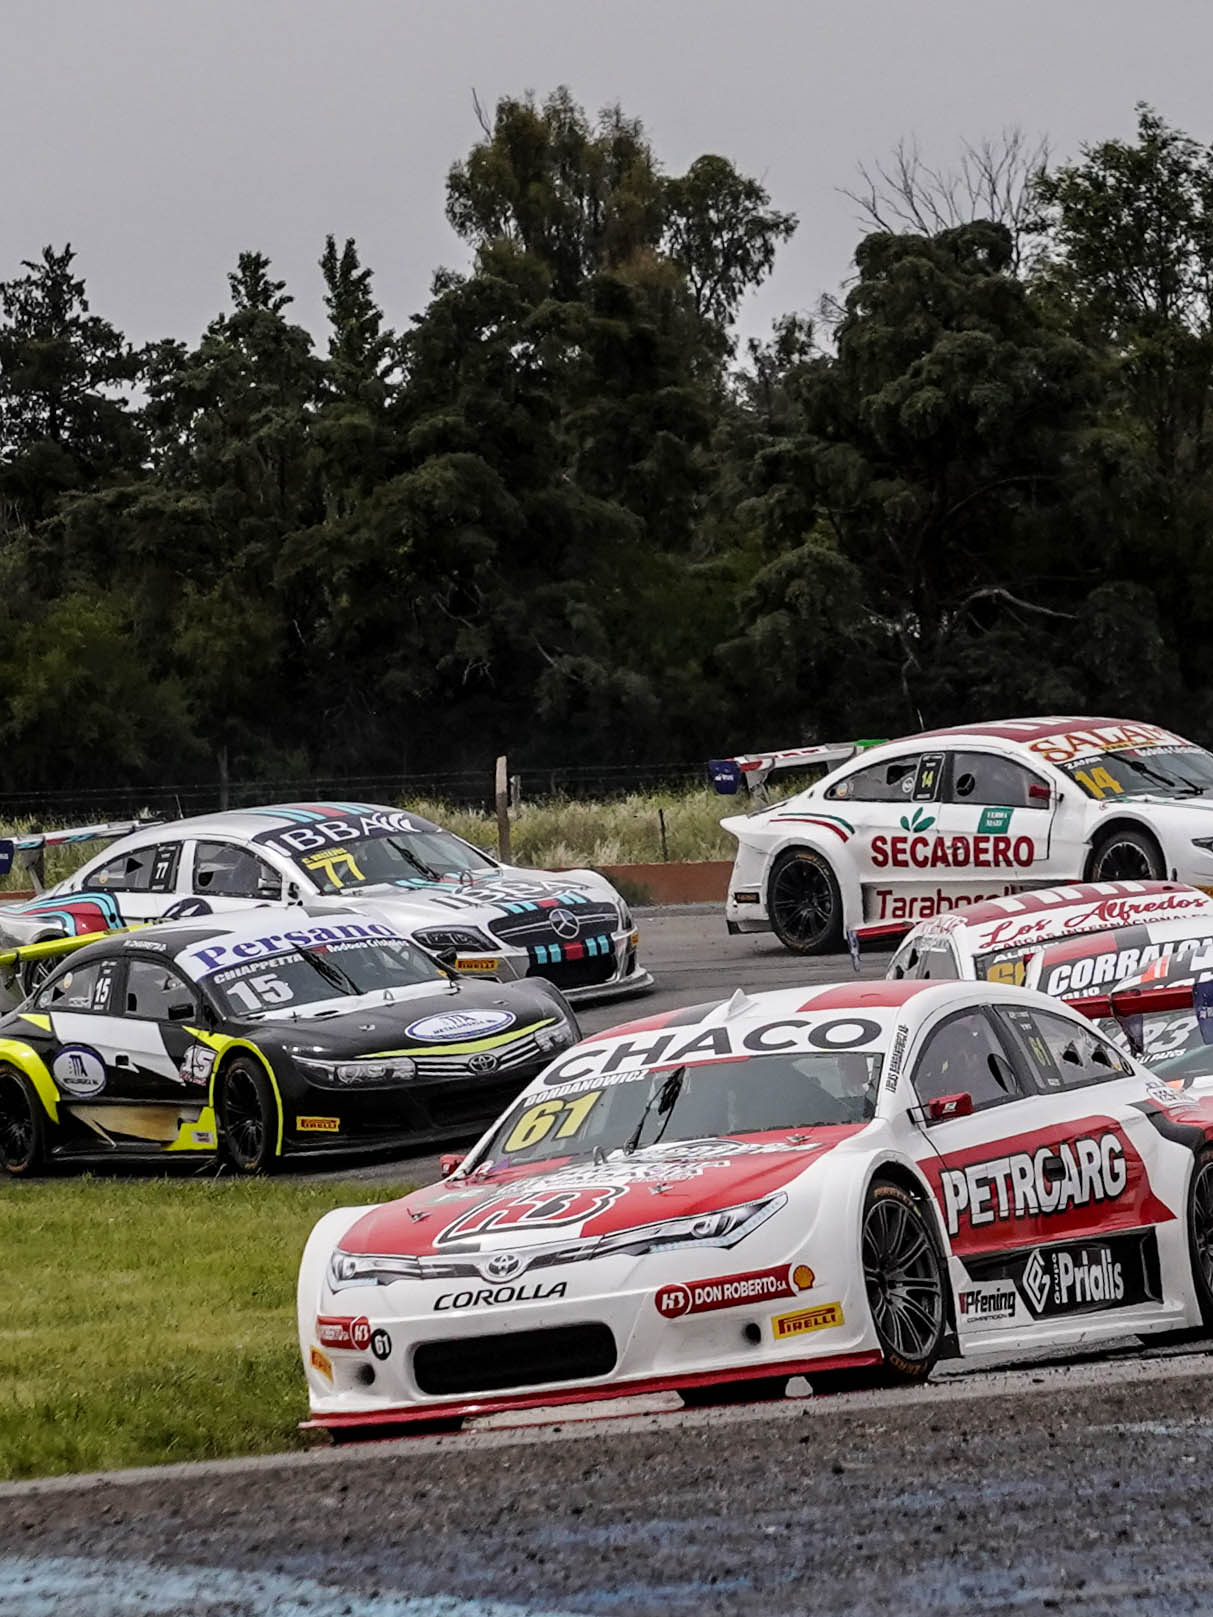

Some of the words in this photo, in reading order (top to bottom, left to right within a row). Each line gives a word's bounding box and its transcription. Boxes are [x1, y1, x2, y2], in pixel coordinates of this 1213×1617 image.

[1075, 767, 1124, 799] 14
[871, 835, 1035, 868] SECADERO
[306, 853, 366, 888] 77
[979, 917, 1052, 949] Los
[1065, 895, 1208, 927] Alfredos
[192, 924, 396, 971] Persano
[95, 978, 111, 1003] 15
[226, 974, 294, 1010] 15
[543, 1018, 882, 1086] CHACO
[523, 1069, 648, 1108] BOHDANOWICZ
[505, 1091, 602, 1153] 61
[695, 1287, 722, 1304] DON
[724, 1276, 776, 1299] ROBERTO
[1058, 1249, 1124, 1304] Prialis
[434, 1281, 567, 1311] COROLLA
[966, 1288, 1016, 1318] Pfening
[778, 1307, 836, 1335] PIRELLI
[374, 1335, 390, 1355] 61
